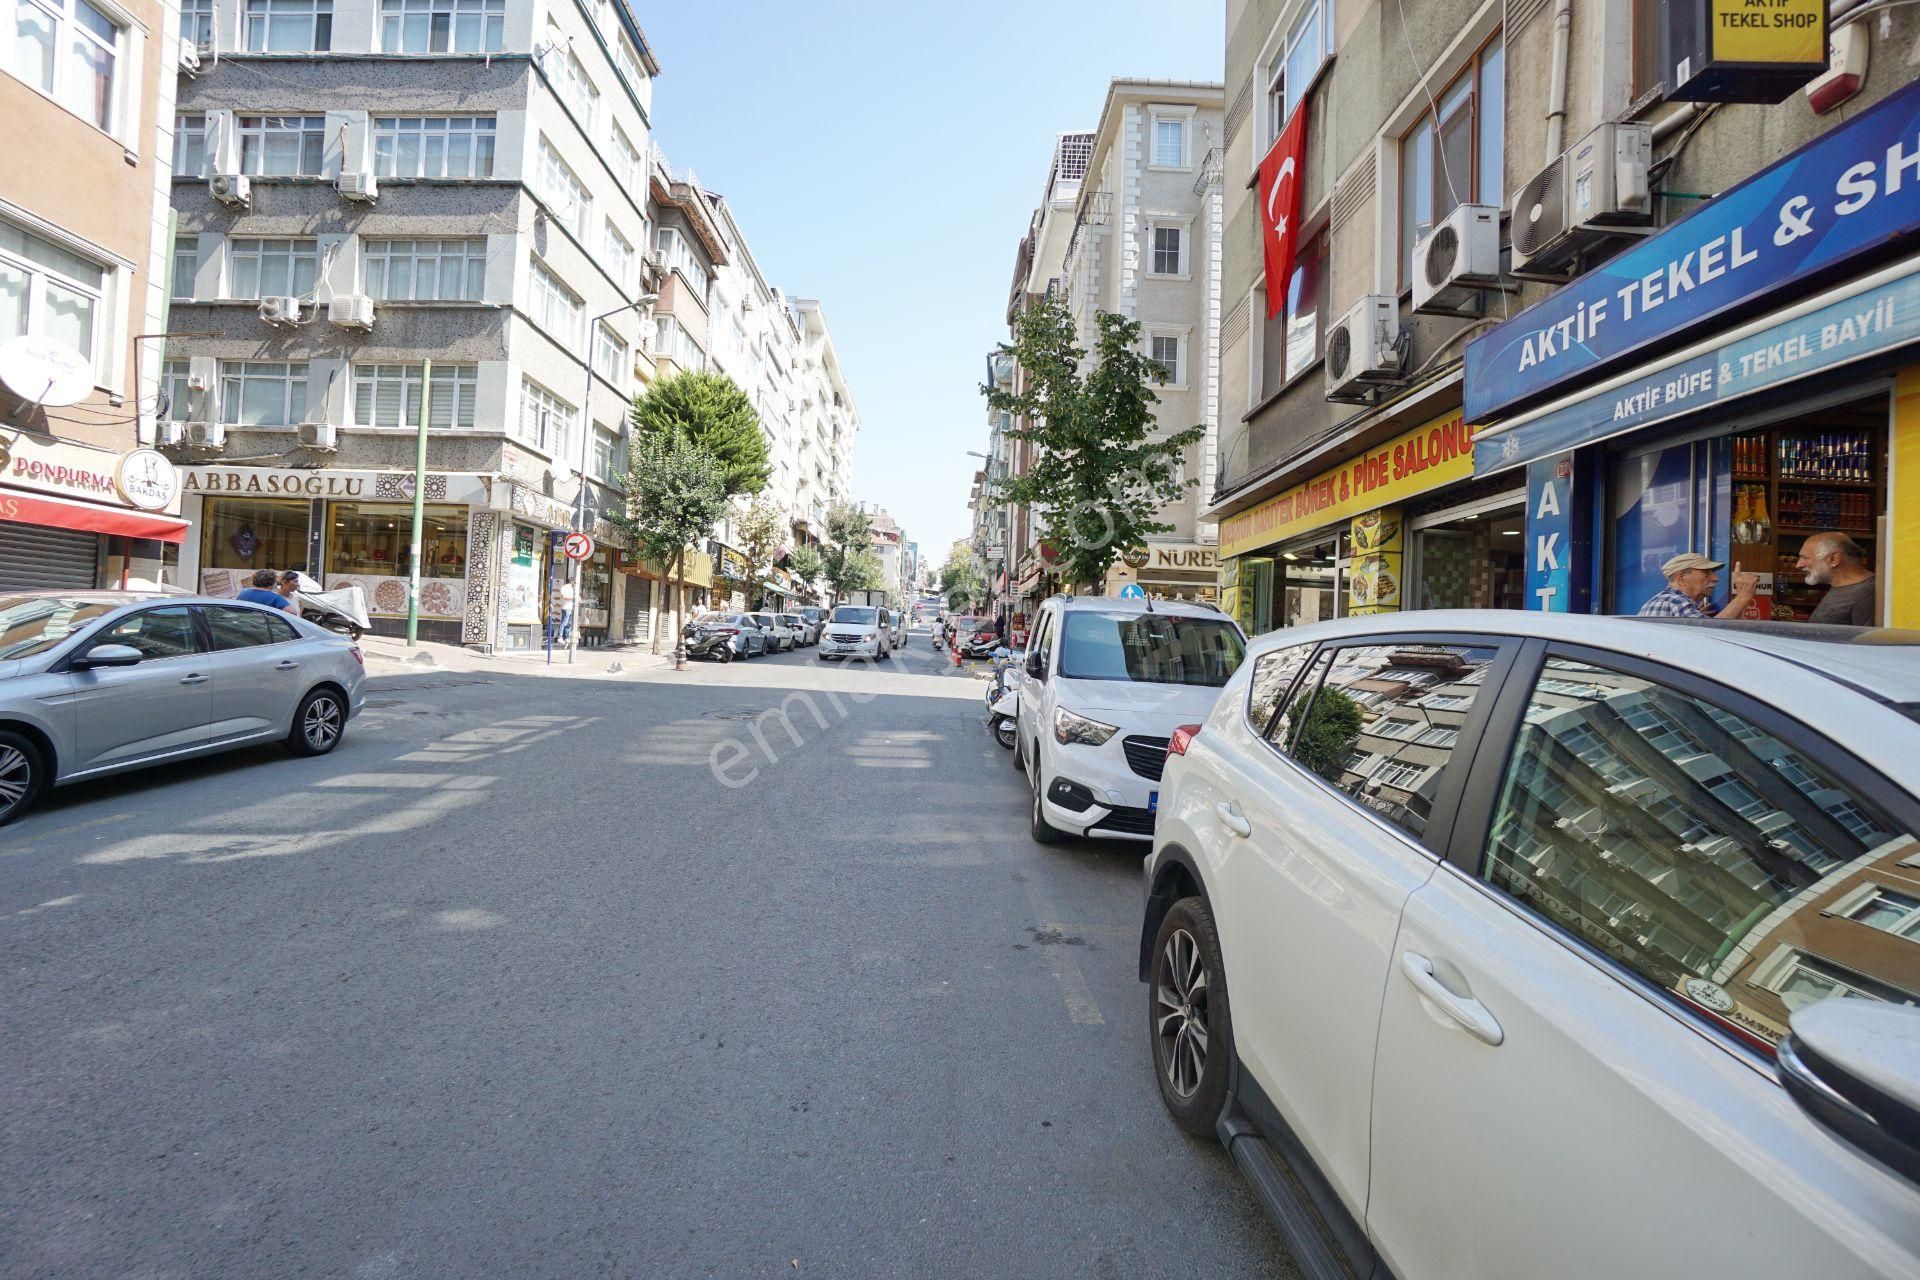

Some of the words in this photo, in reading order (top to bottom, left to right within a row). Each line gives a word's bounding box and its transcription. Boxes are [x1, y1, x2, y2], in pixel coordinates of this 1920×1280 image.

[1720, 13, 1769, 28] TEKEL
[1773, 13, 1817, 28] SHOP
[1518, 298, 1608, 372] AKTİF
[1616, 225, 1758, 323] TEKEL
[1773, 194, 1815, 247] &
[1613, 384, 1661, 421] AKTİF
[1665, 367, 1713, 404] BÜFE
[1718, 363, 1733, 386] &
[1738, 338, 1813, 379] TEKEL
[1820, 295, 1895, 353] BAYİİ
[16, 457, 116, 489] DONDURMA
[184, 470, 364, 497] ABBASOĞLU
[1296, 475, 1337, 519] BÖREK
[1339, 471, 1350, 501] &
[1352, 452, 1389, 497] PİDE
[1393, 416, 1474, 480] SALONU
